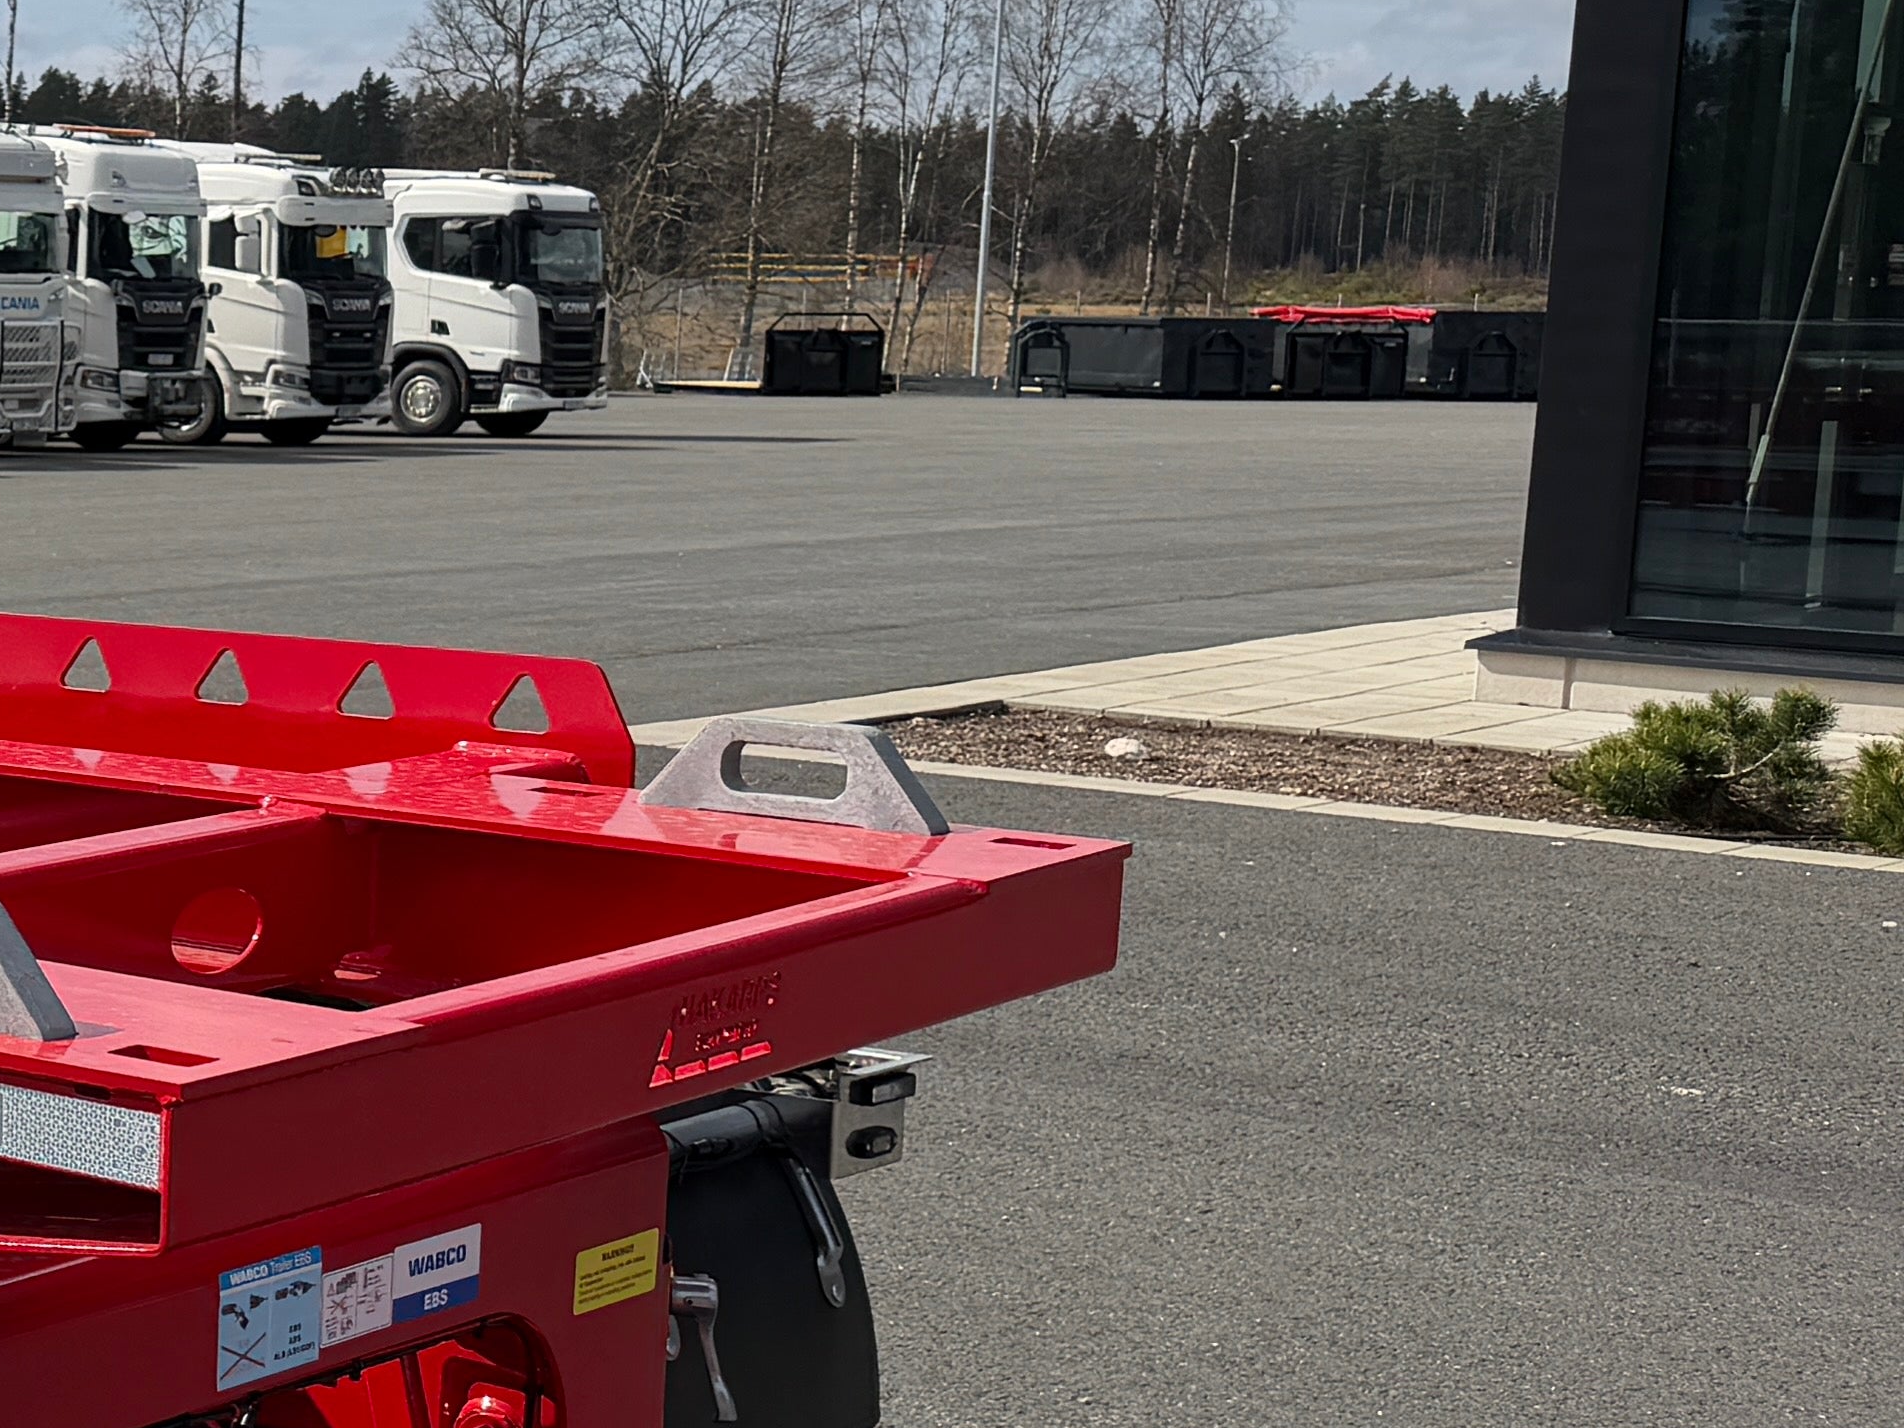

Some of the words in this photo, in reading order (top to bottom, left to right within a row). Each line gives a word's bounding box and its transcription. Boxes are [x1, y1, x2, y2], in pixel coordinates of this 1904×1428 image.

[408, 1243, 467, 1278] WABCO
[229, 1263, 269, 1286] WABCO
[423, 1288, 449, 1311] EBS
